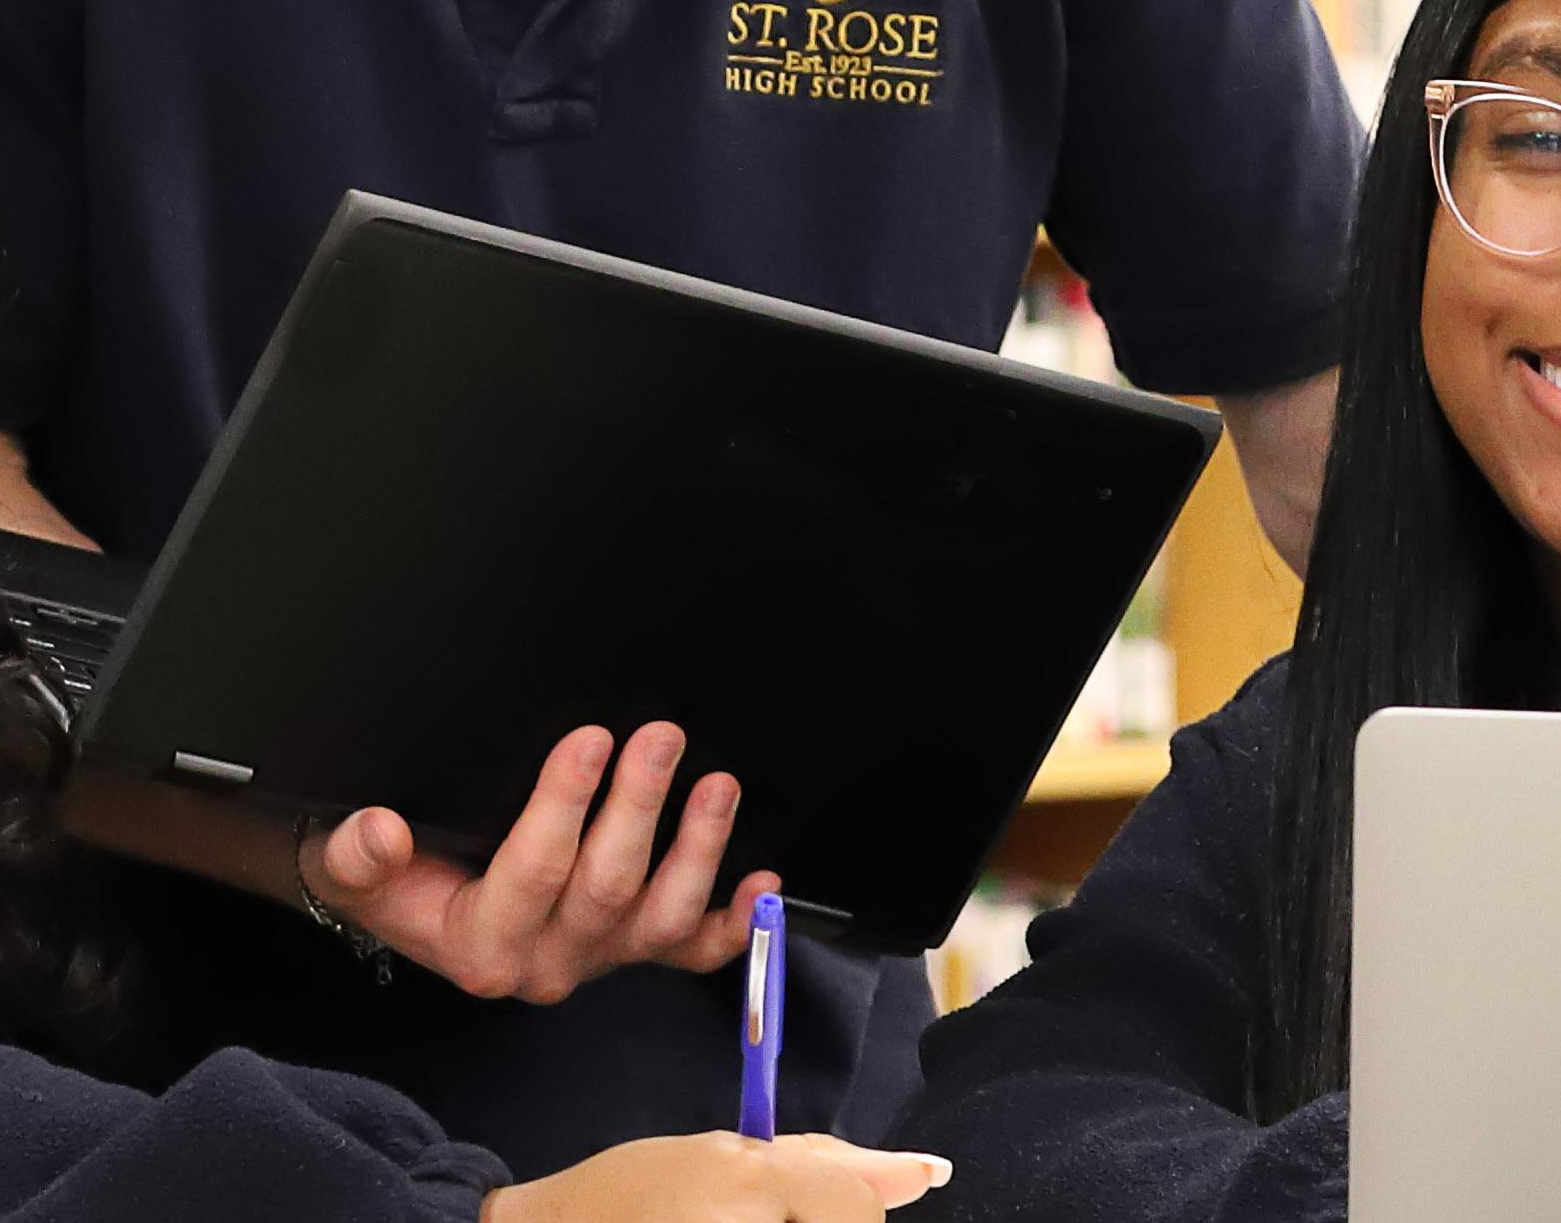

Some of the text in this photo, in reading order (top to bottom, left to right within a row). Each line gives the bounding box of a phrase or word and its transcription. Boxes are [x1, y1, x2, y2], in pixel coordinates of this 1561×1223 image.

[727, 1, 939, 60] ST. ROSE
[725, 67, 932, 106] HIGH SCHOOL
